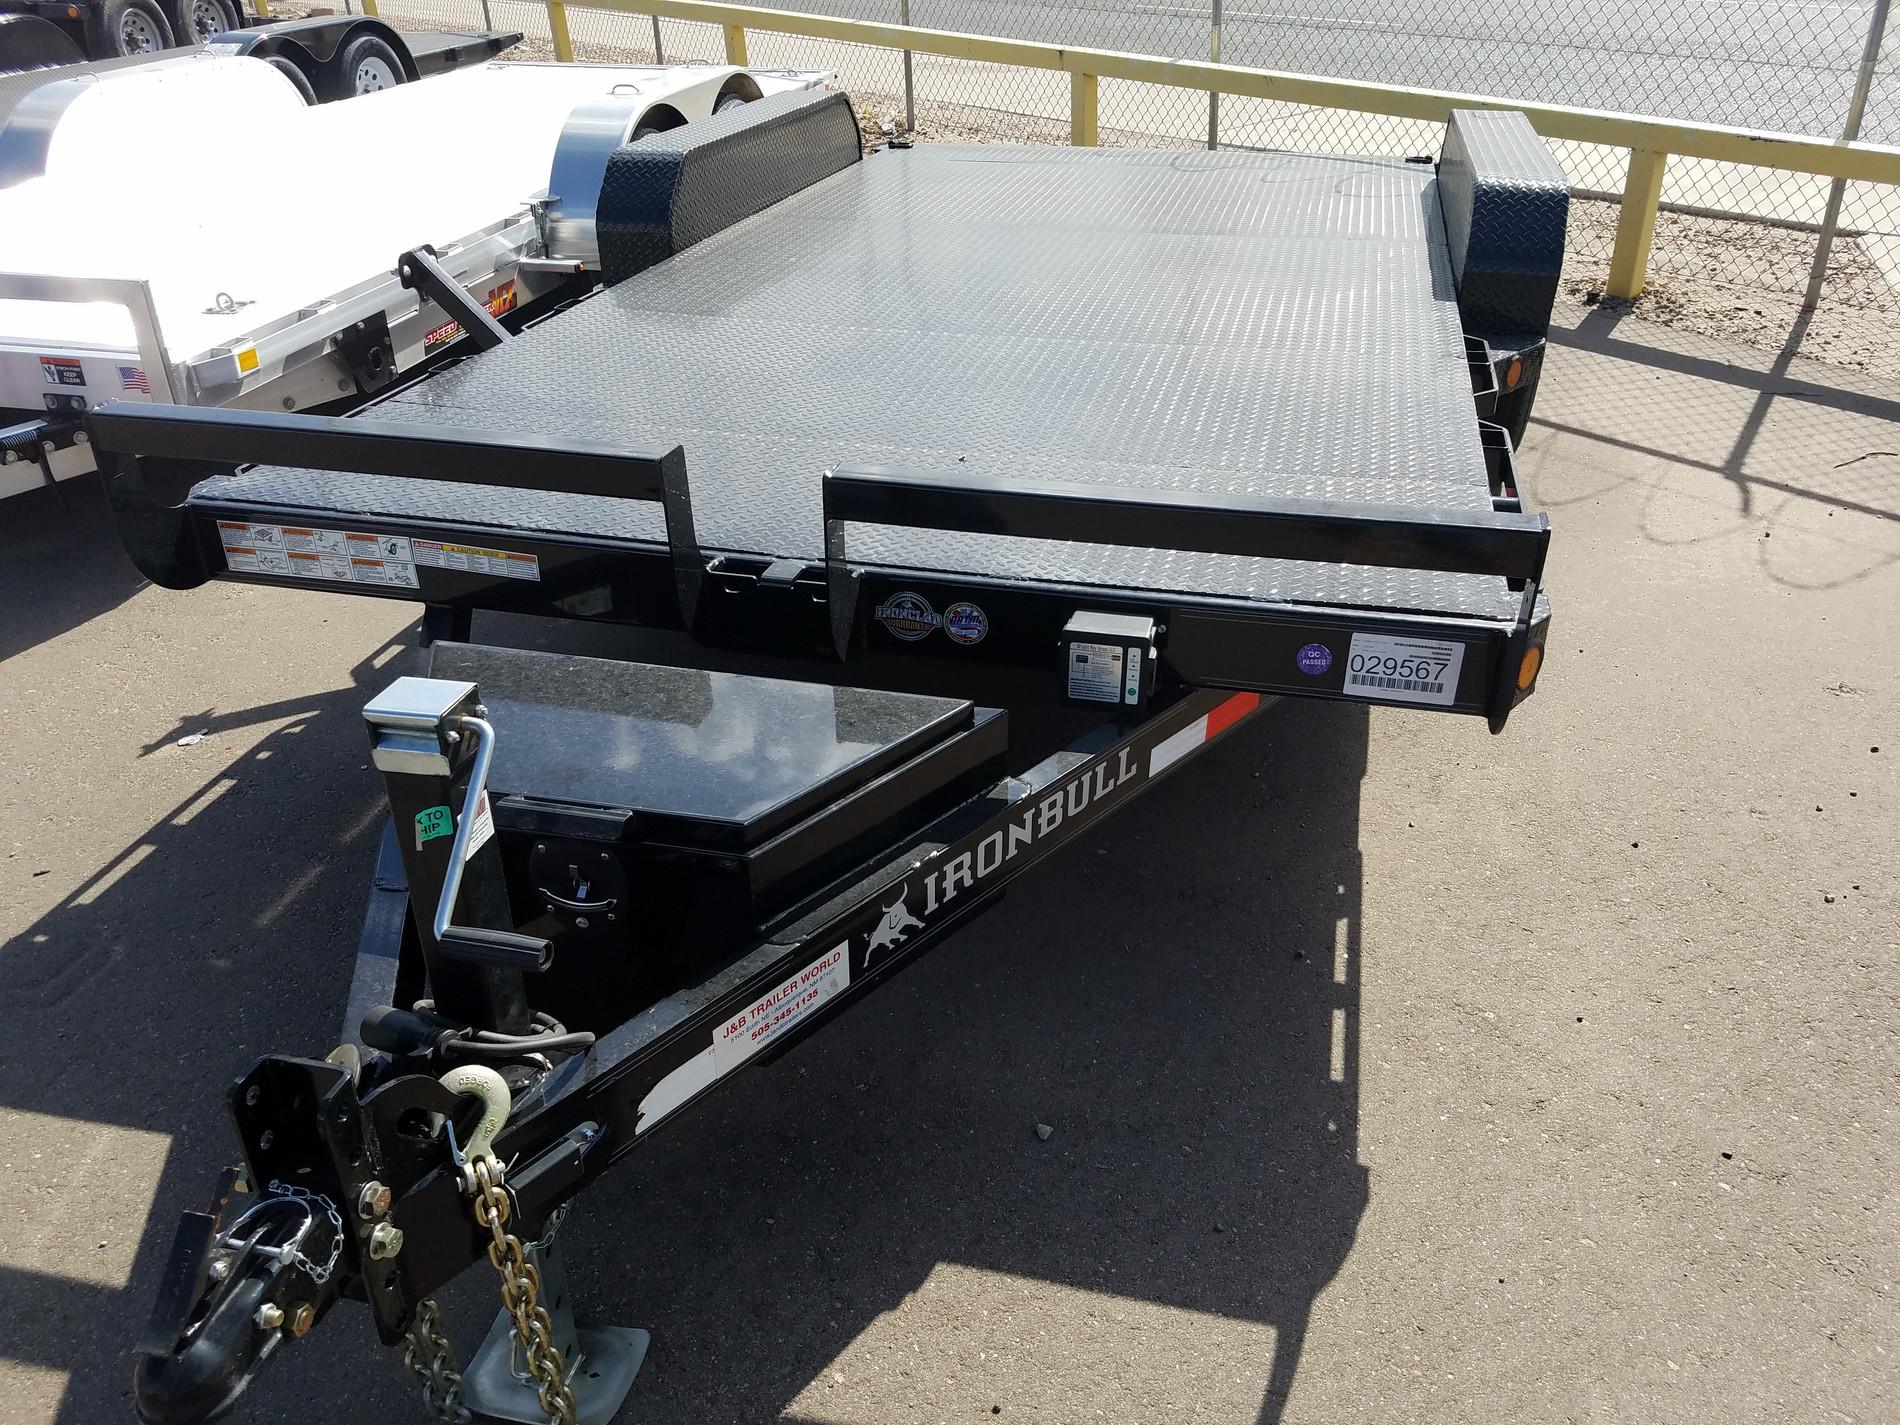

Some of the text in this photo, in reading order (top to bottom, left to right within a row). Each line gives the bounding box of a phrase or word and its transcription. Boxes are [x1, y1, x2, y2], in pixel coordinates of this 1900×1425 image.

[424, 320, 459, 347] SPEED
[419, 542, 442, 550] DANGER
[456, 547, 481, 555] CAUTION
[876, 606, 942, 627] IRONCLAD
[1350, 654, 1448, 681] 029567
[425, 810, 443, 823] TO
[924, 746, 1138, 916] IRONBULL
[723, 951, 841, 1039] J&B TRAILER WORLD
[751, 988, 818, 1041] 505-345-1135
